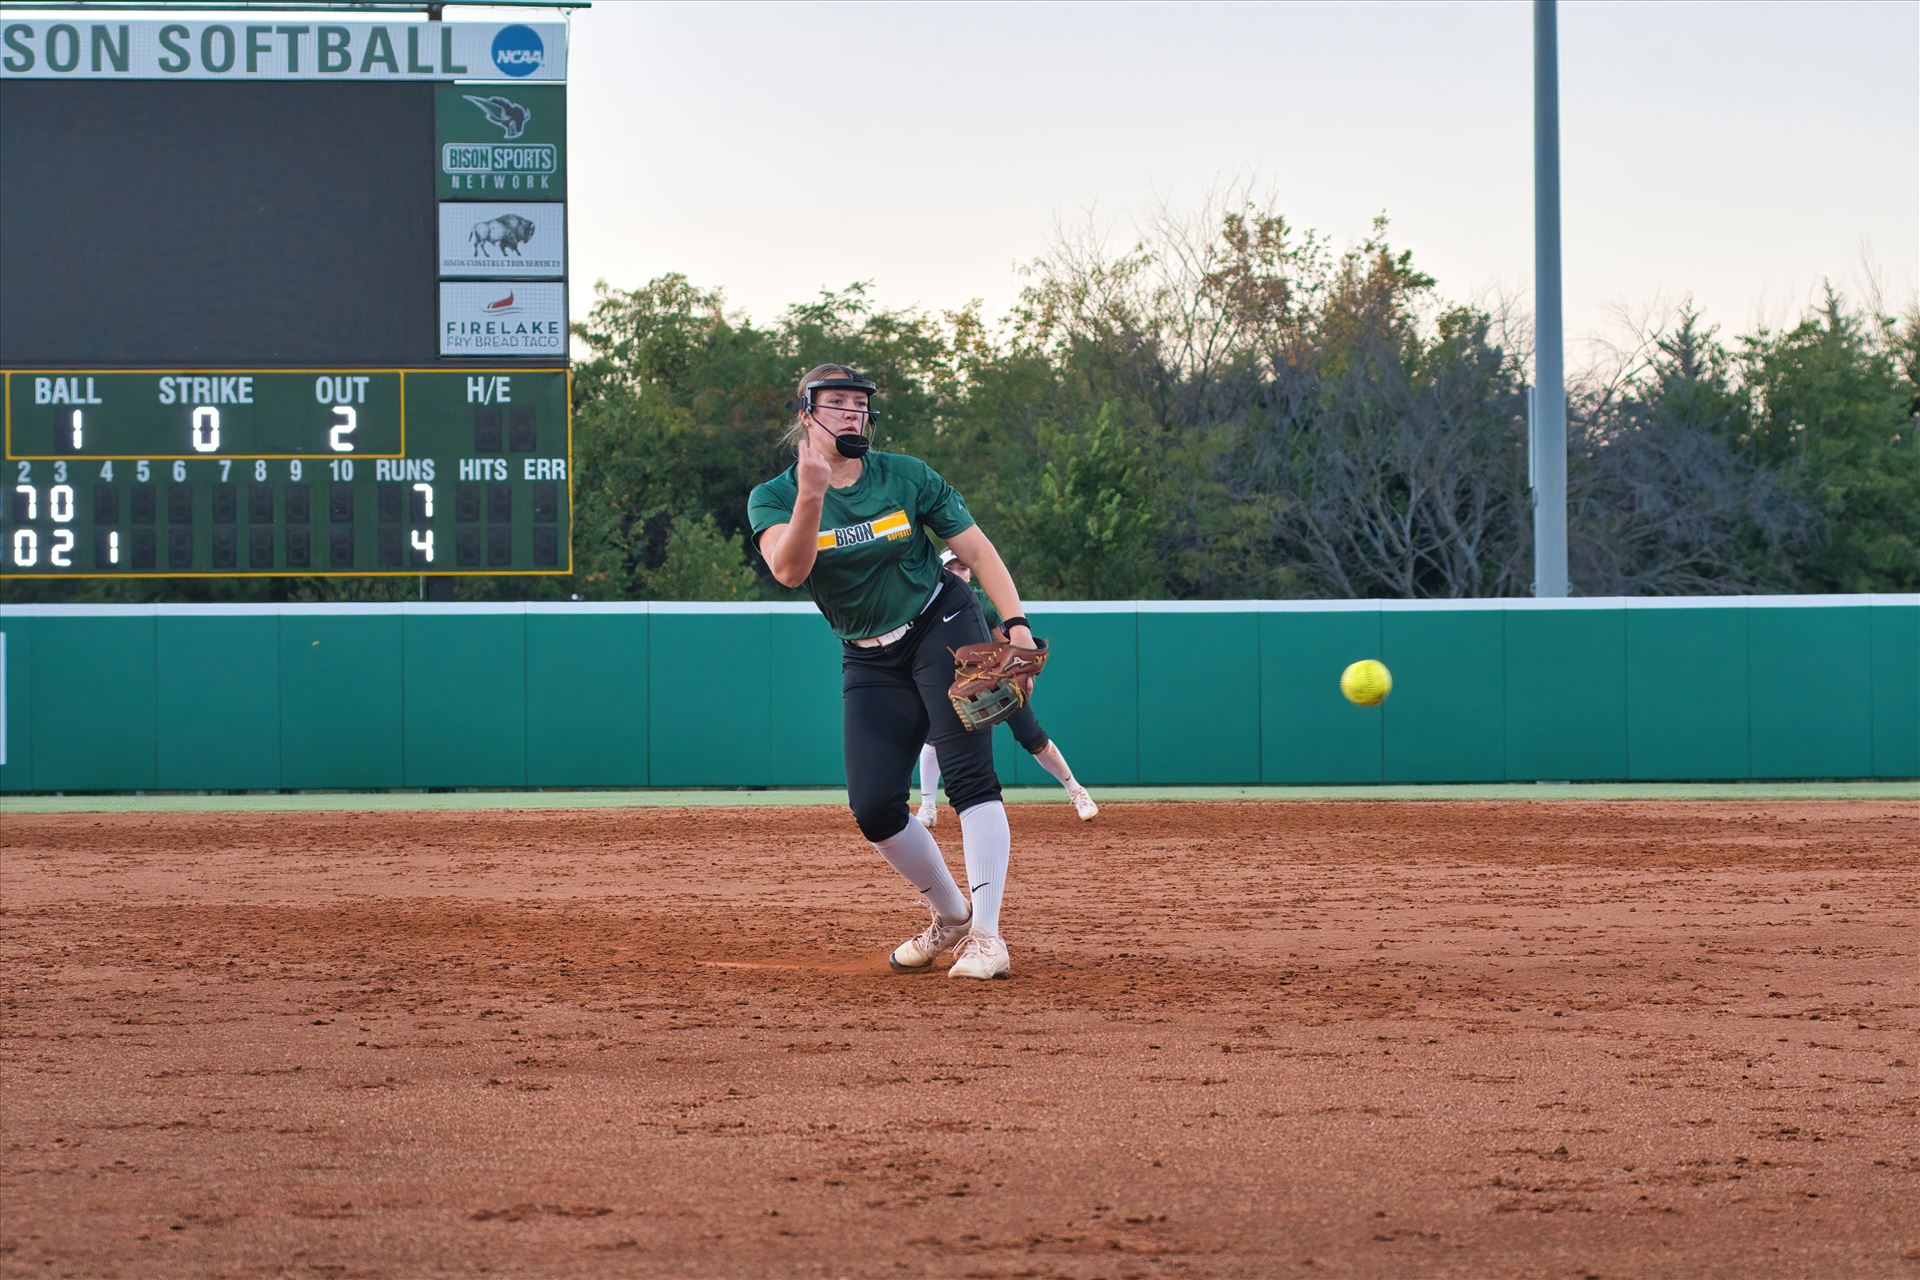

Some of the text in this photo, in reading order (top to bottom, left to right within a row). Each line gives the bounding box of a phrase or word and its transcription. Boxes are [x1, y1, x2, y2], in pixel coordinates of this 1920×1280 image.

[157, 24, 468, 74] SOFTBALL
[496, 49, 543, 64] NCAA
[449, 148, 552, 169] BISON SPORTS
[451, 174, 549, 190] NETWORK
[446, 321, 559, 335] FIRELAKE
[446, 336, 559, 347] FRY BREAD TACO
[34, 376, 511, 405] BALL STRIKE OUT H/E
[72, 406, 357, 452] 1 0 2
[18, 458, 566, 483] 2 3 4 5 6 7 8 9 10 RUNS HITS ERR
[16, 484, 434, 522] 7 0 7
[832, 521, 876, 548] BISON
[14, 529, 434, 567] 0 2 1 4
